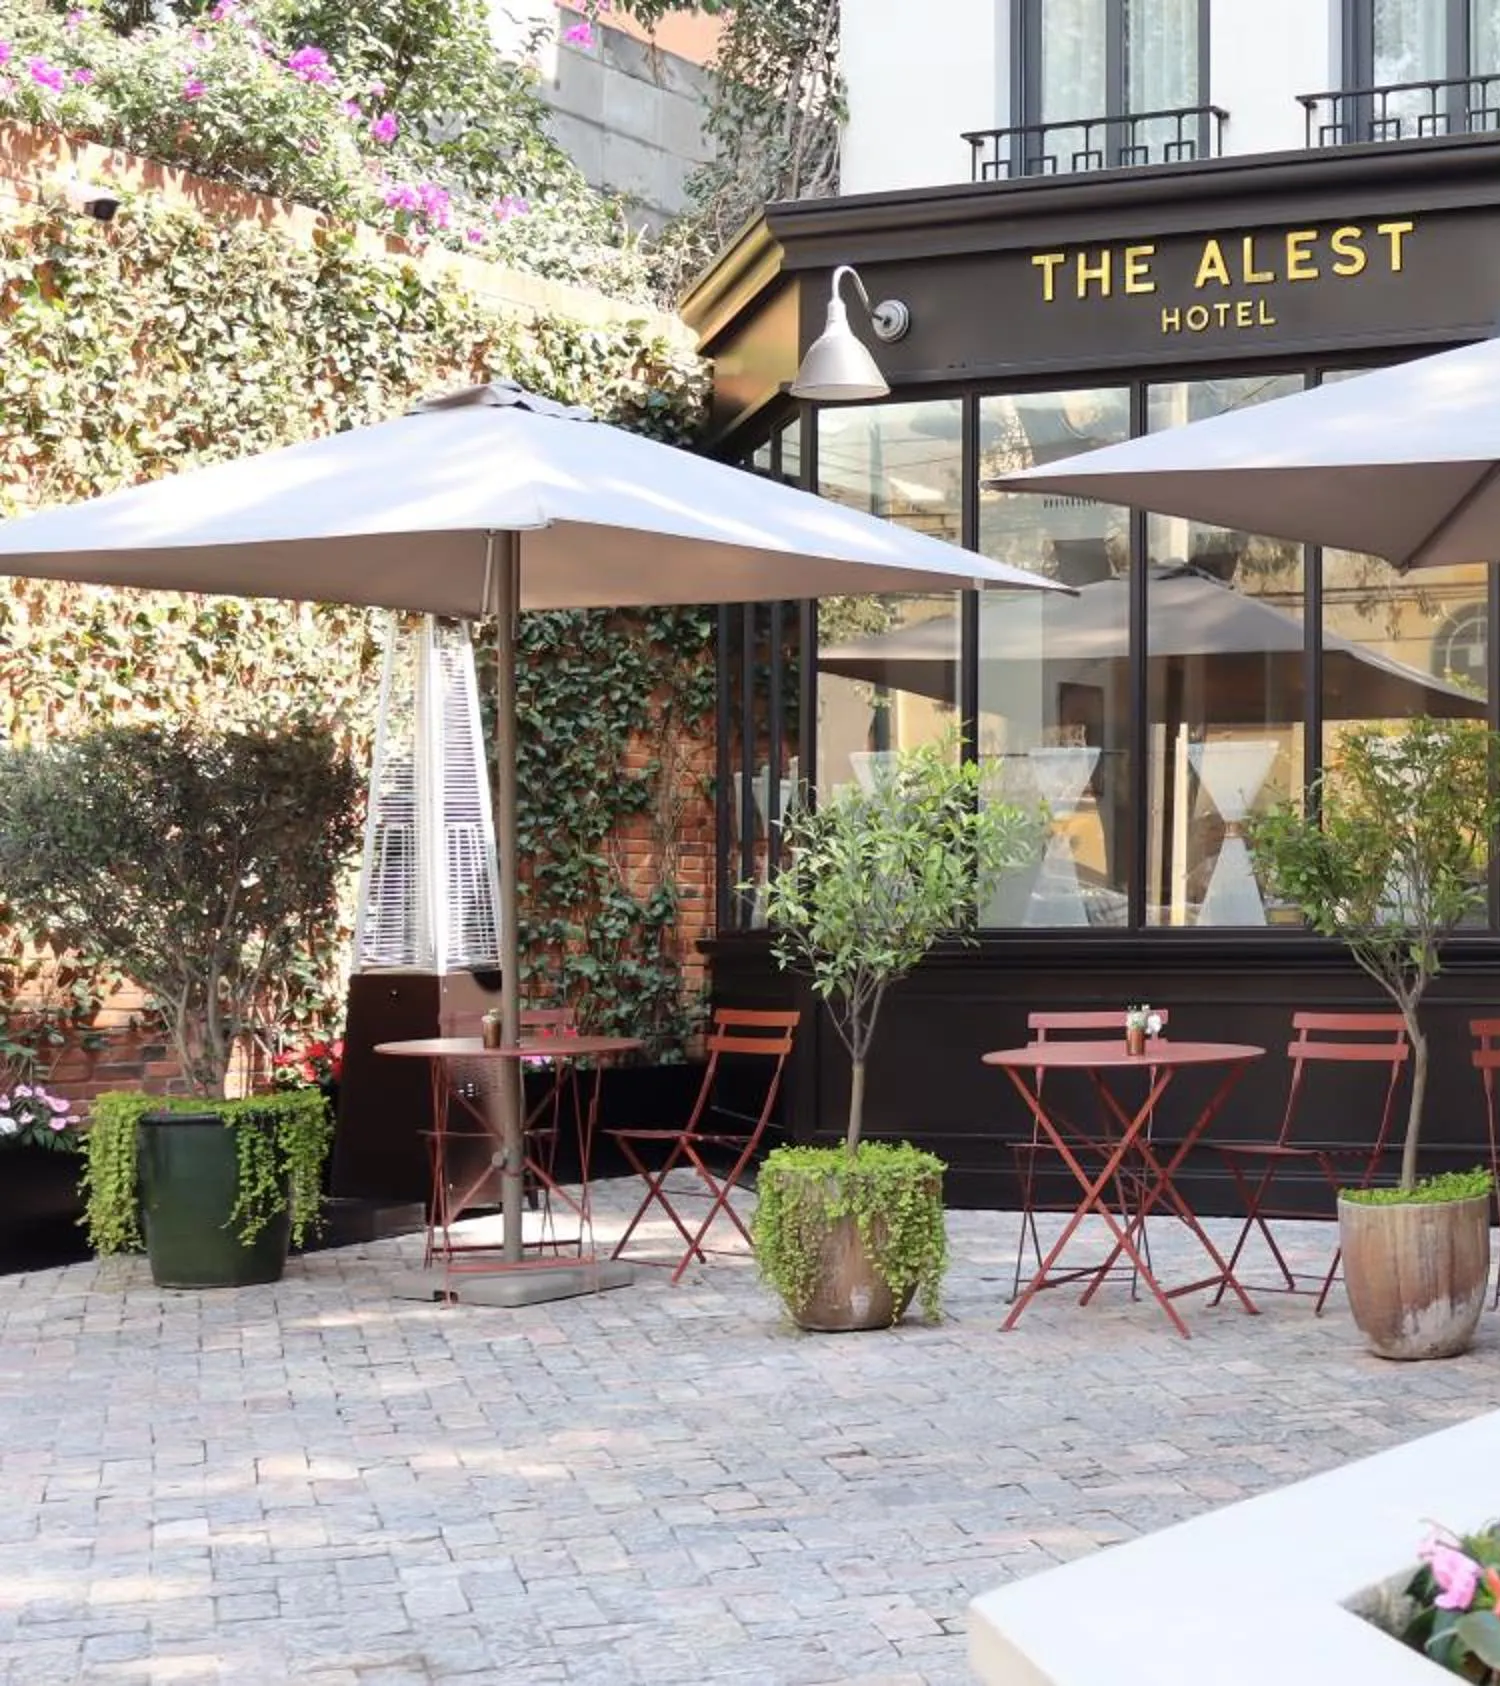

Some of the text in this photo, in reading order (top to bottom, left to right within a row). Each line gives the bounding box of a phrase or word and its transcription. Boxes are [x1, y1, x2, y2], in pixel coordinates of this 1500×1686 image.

[1032, 222, 1413, 301] THE ALEST
[1161, 300, 1276, 333] HOTEL
